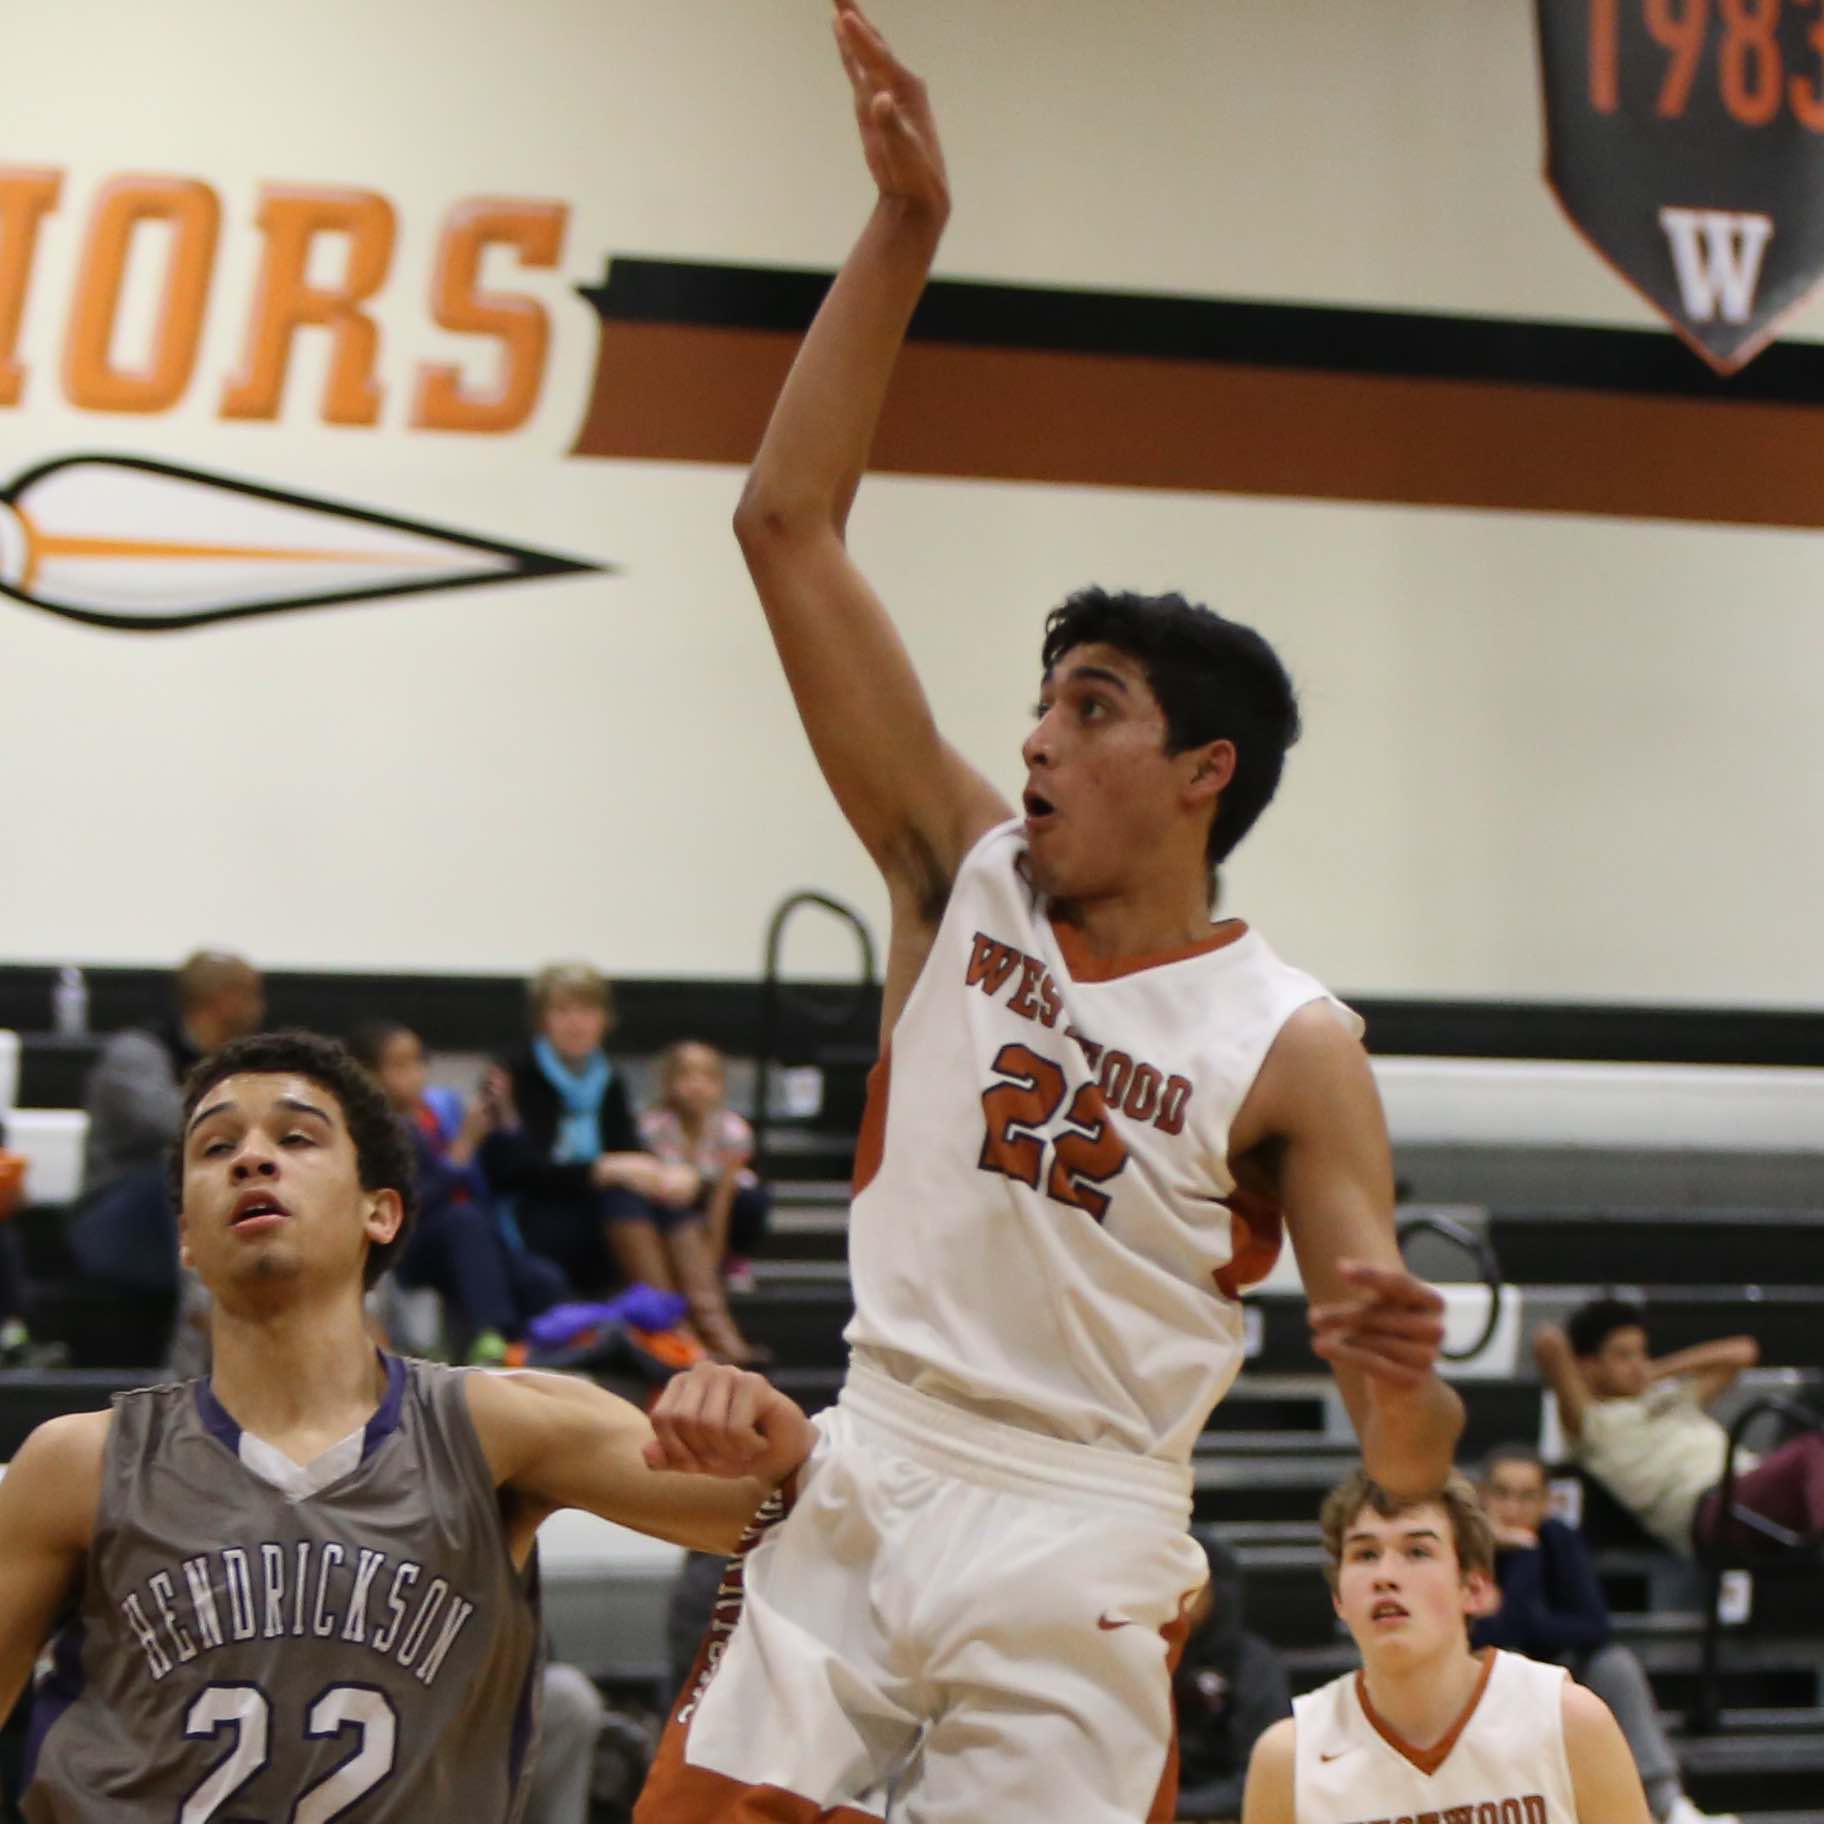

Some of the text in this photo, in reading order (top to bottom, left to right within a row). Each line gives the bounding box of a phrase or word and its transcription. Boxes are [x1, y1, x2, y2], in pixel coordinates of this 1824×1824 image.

[1660, 207, 1773, 324] W
[976, 1042, 1132, 1226] 22
[119, 1540, 473, 1686] HENDRICKSON
